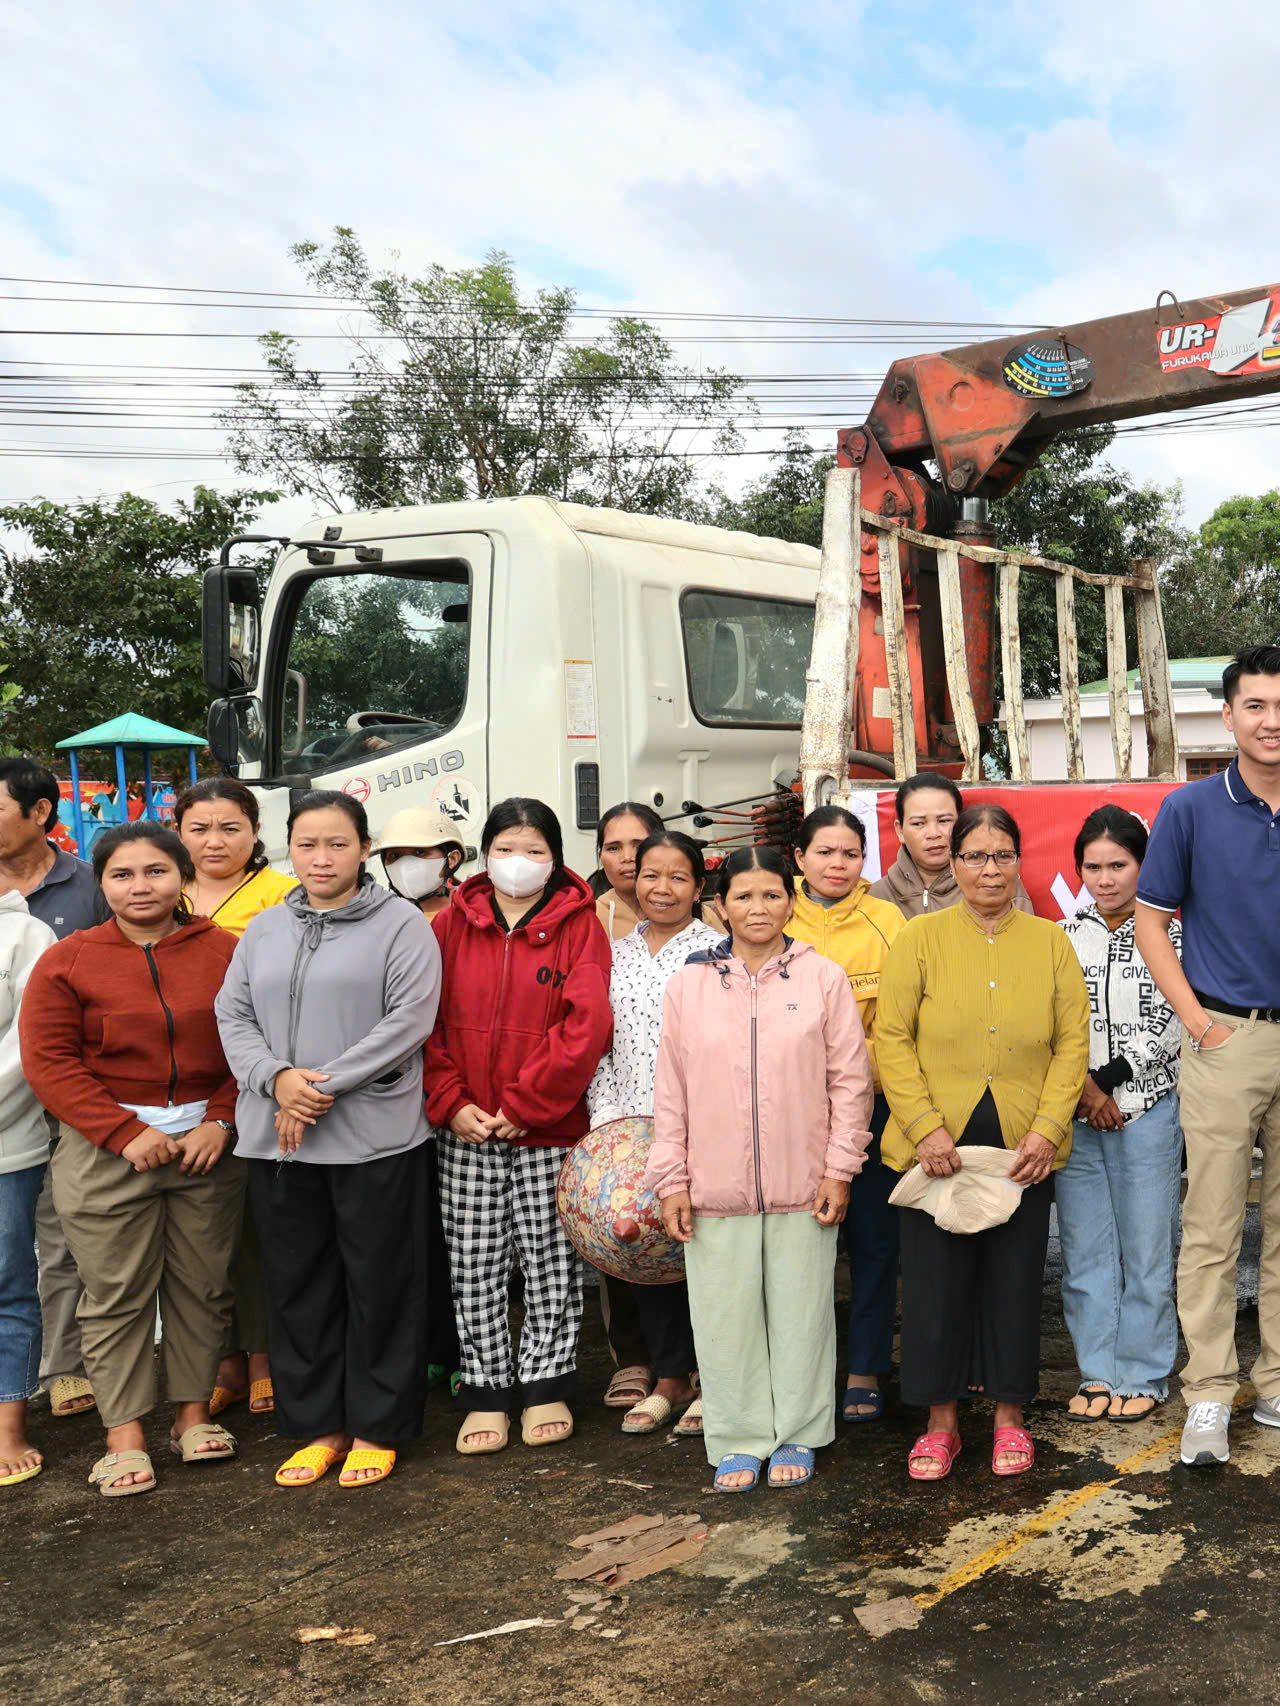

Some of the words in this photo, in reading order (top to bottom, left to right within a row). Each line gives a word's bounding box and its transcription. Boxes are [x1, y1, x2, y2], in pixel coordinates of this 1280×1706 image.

[1160, 324, 1217, 354] UR-
[1162, 349, 1228, 370] FURUKAWA
[376, 750, 465, 792] HINO
